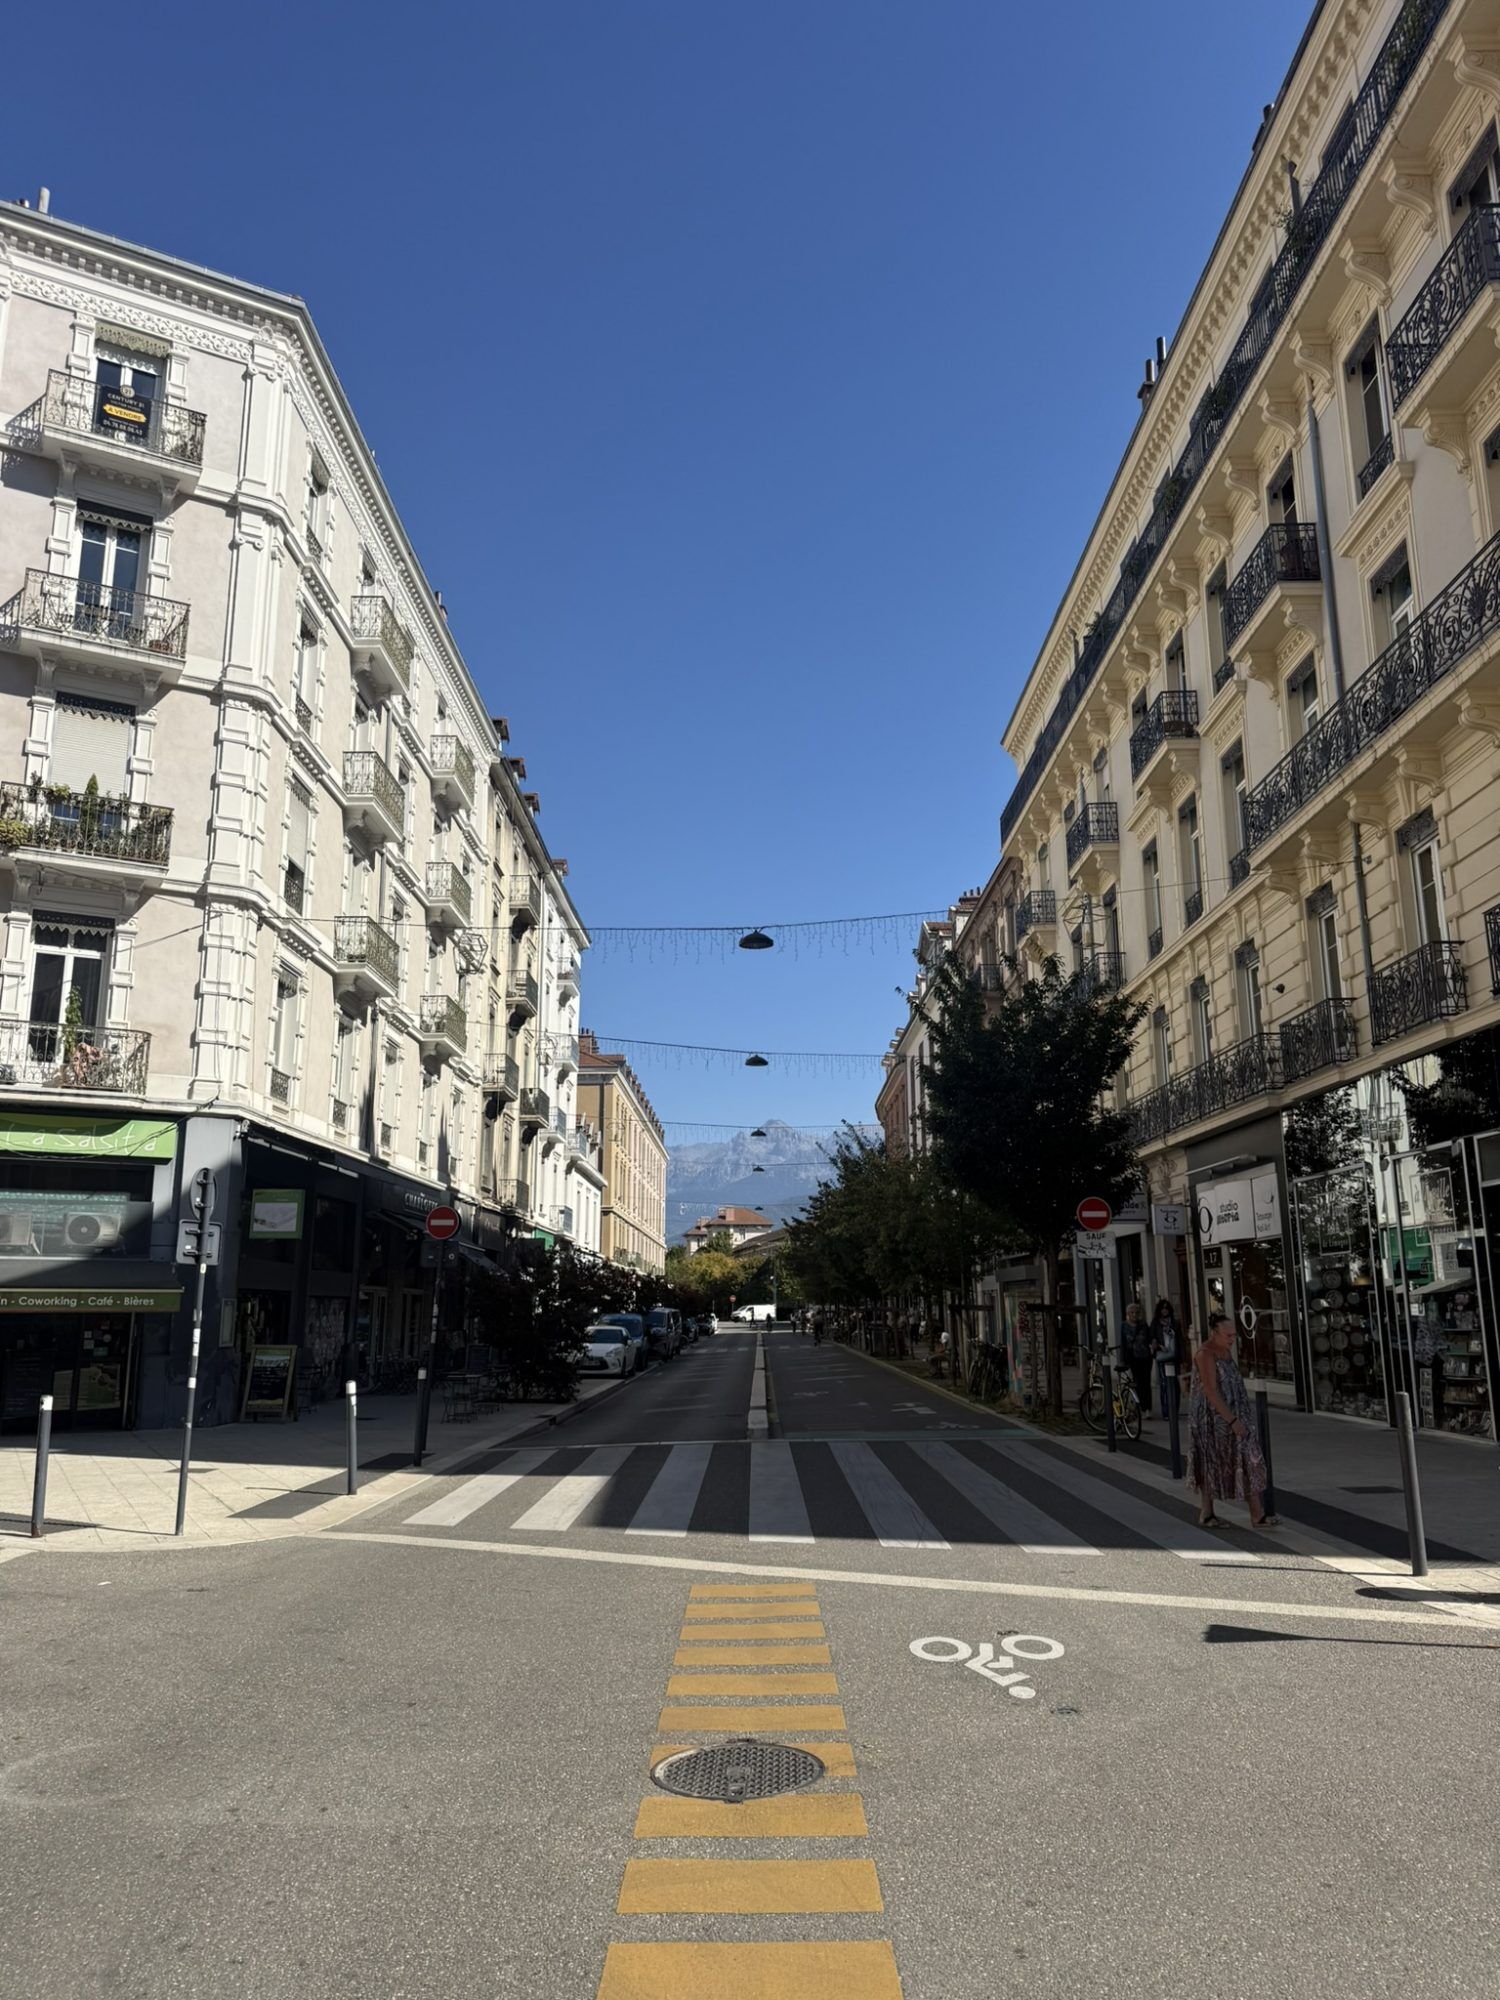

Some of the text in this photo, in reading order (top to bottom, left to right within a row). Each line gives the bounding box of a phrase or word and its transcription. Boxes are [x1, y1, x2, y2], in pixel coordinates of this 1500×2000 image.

[107, 393, 138, 405] CENTURY
[114, 409, 142, 420] VENDRE
[6, 1123, 157, 1154] La Salsita
[1086, 1232, 1106, 1240] SAUF
[18, 1296, 78, 1308] Coworking
[88, 1296, 114, 1306] Café
[123, 1295, 155, 1306] Bières
